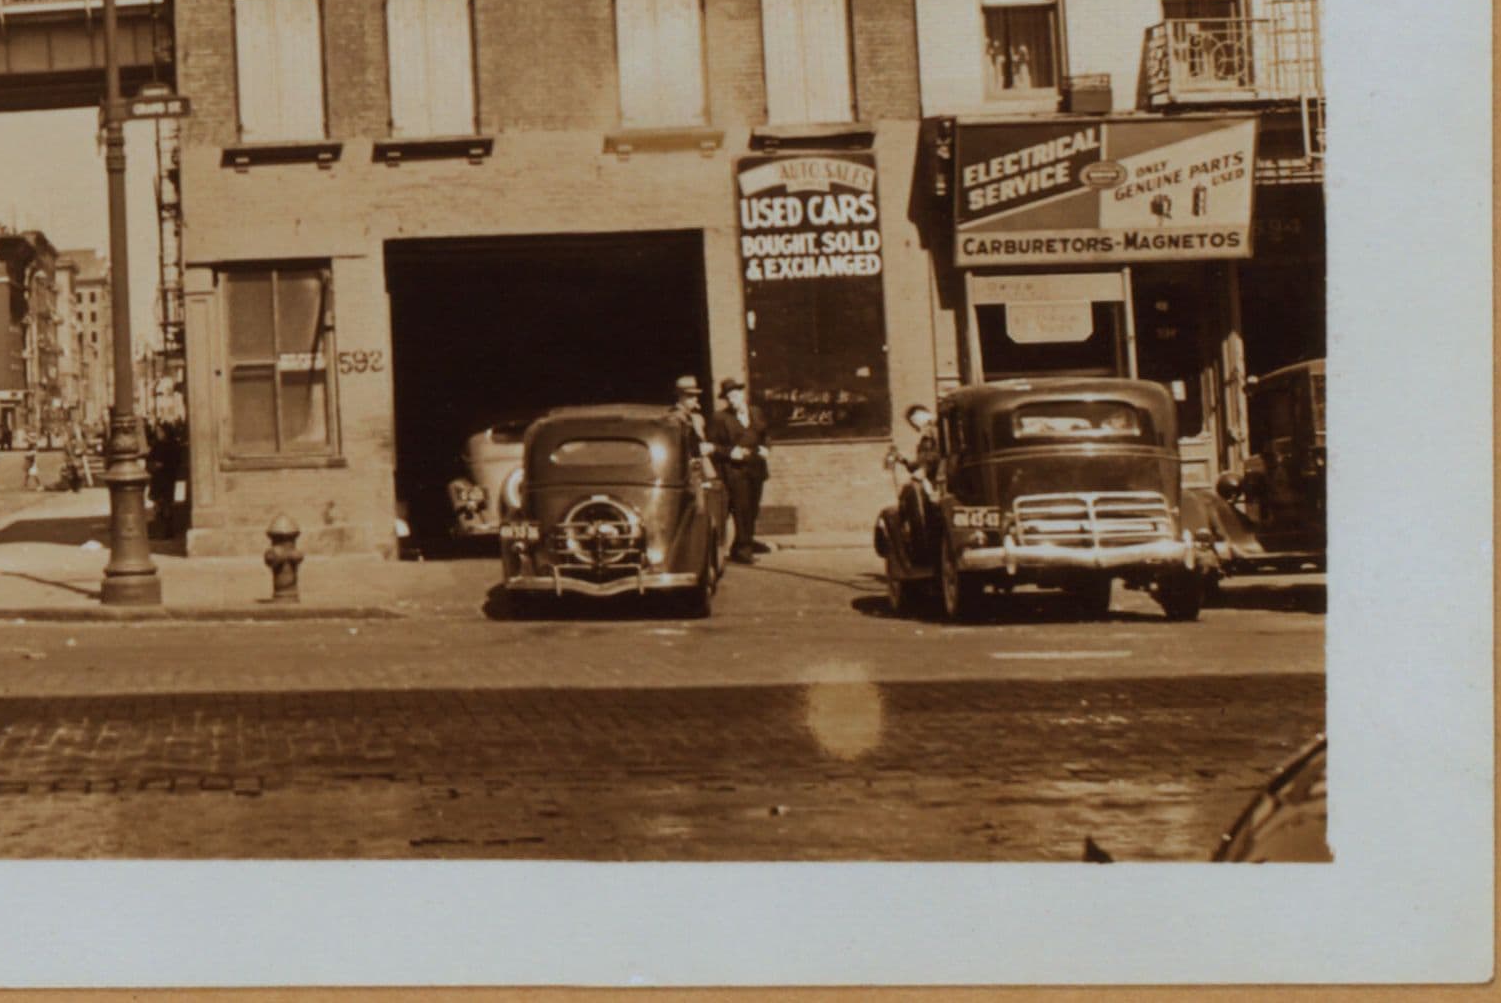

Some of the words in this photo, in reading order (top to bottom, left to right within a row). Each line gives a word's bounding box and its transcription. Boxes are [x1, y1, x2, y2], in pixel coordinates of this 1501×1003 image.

[963, 128, 1100, 188] ELECTRICAL
[1135, 160, 1168, 177] ONLY
[968, 162, 1071, 211] SERVICE
[1114, 169, 1182, 201] GENUINE
[1188, 150, 1244, 179] PARTS
[1211, 168, 1245, 186] USED
[741, 196, 803, 229] USED
[807, 193, 877, 225] CARS
[821, 229, 880, 254] SOLD
[763, 253, 881, 280] EXCHANGED
[339, 349, 384, 374] 592
